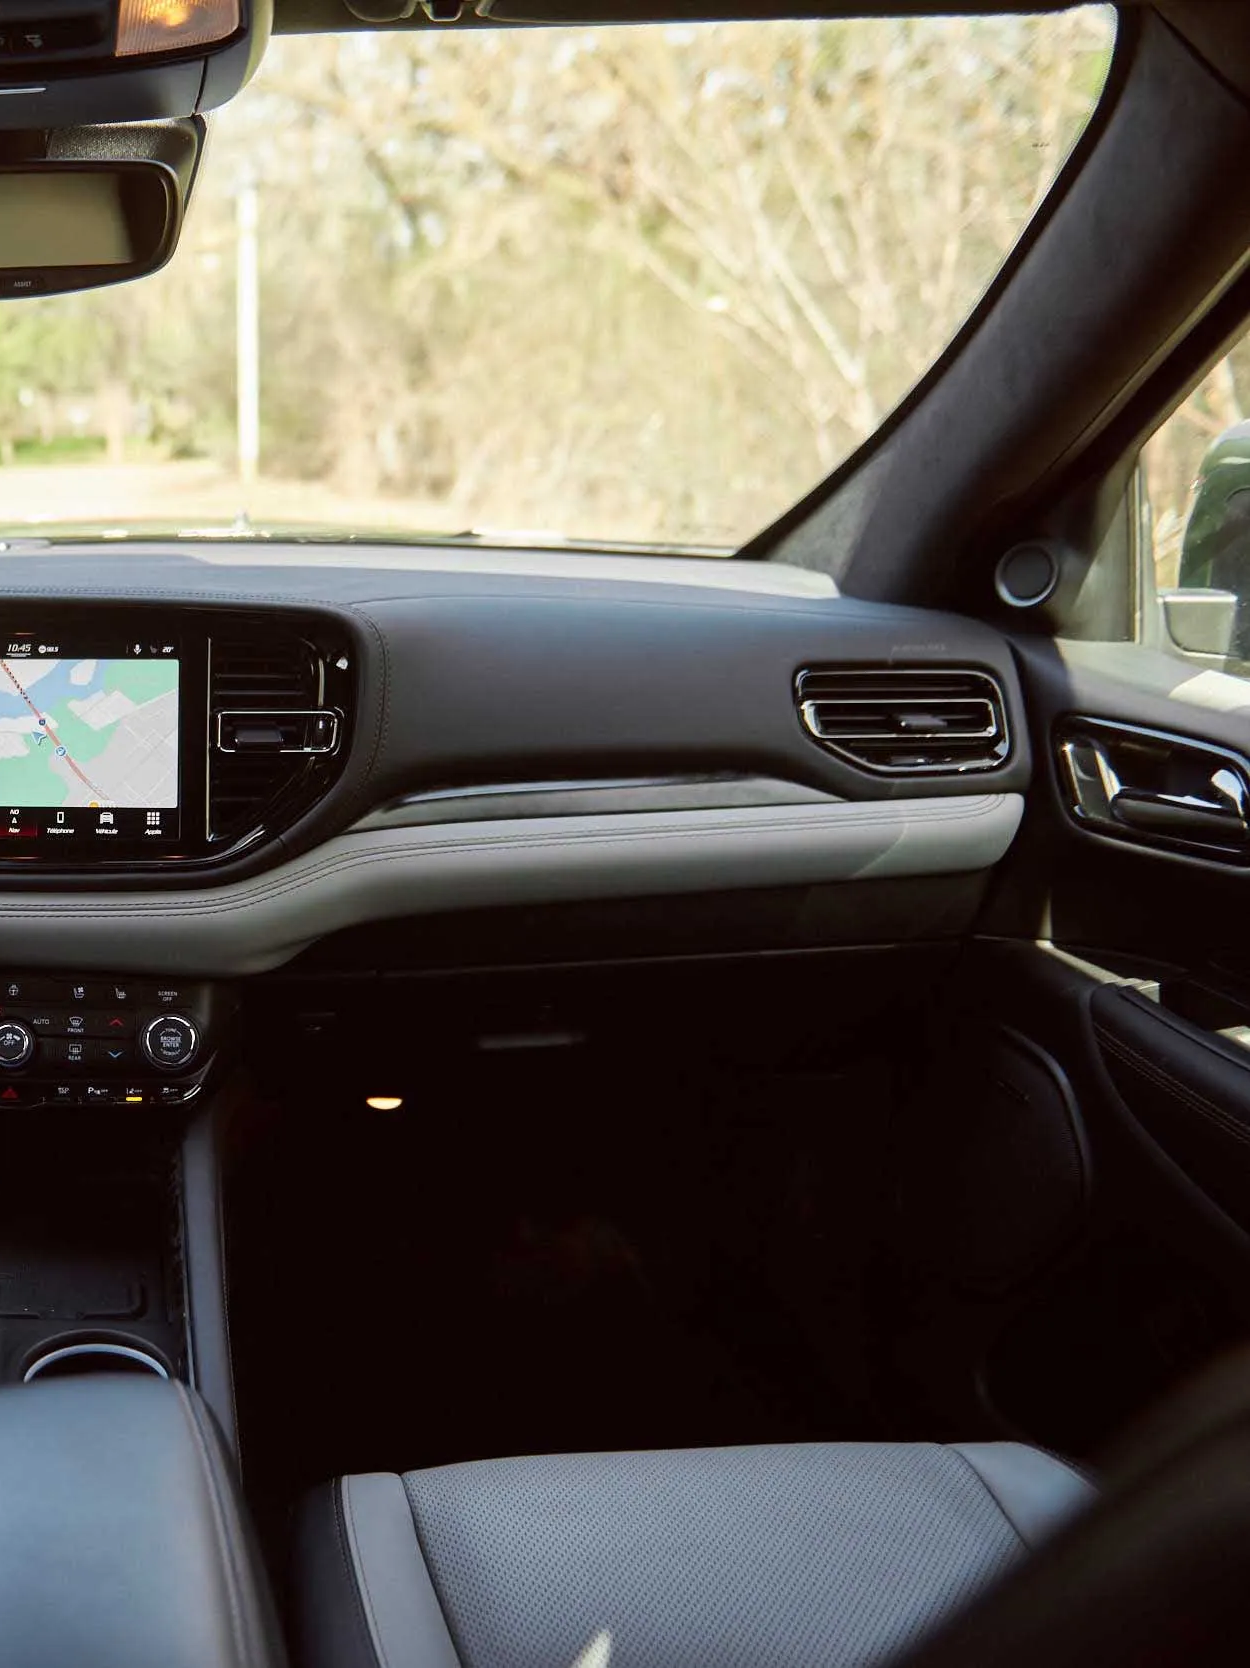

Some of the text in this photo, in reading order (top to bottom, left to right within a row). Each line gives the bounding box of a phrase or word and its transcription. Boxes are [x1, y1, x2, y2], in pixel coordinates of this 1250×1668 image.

[13, 280, 32, 288] ASSIST
[46, 827, 75, 835] Téléphone
[3, 1039, 15, 1047] OFF
